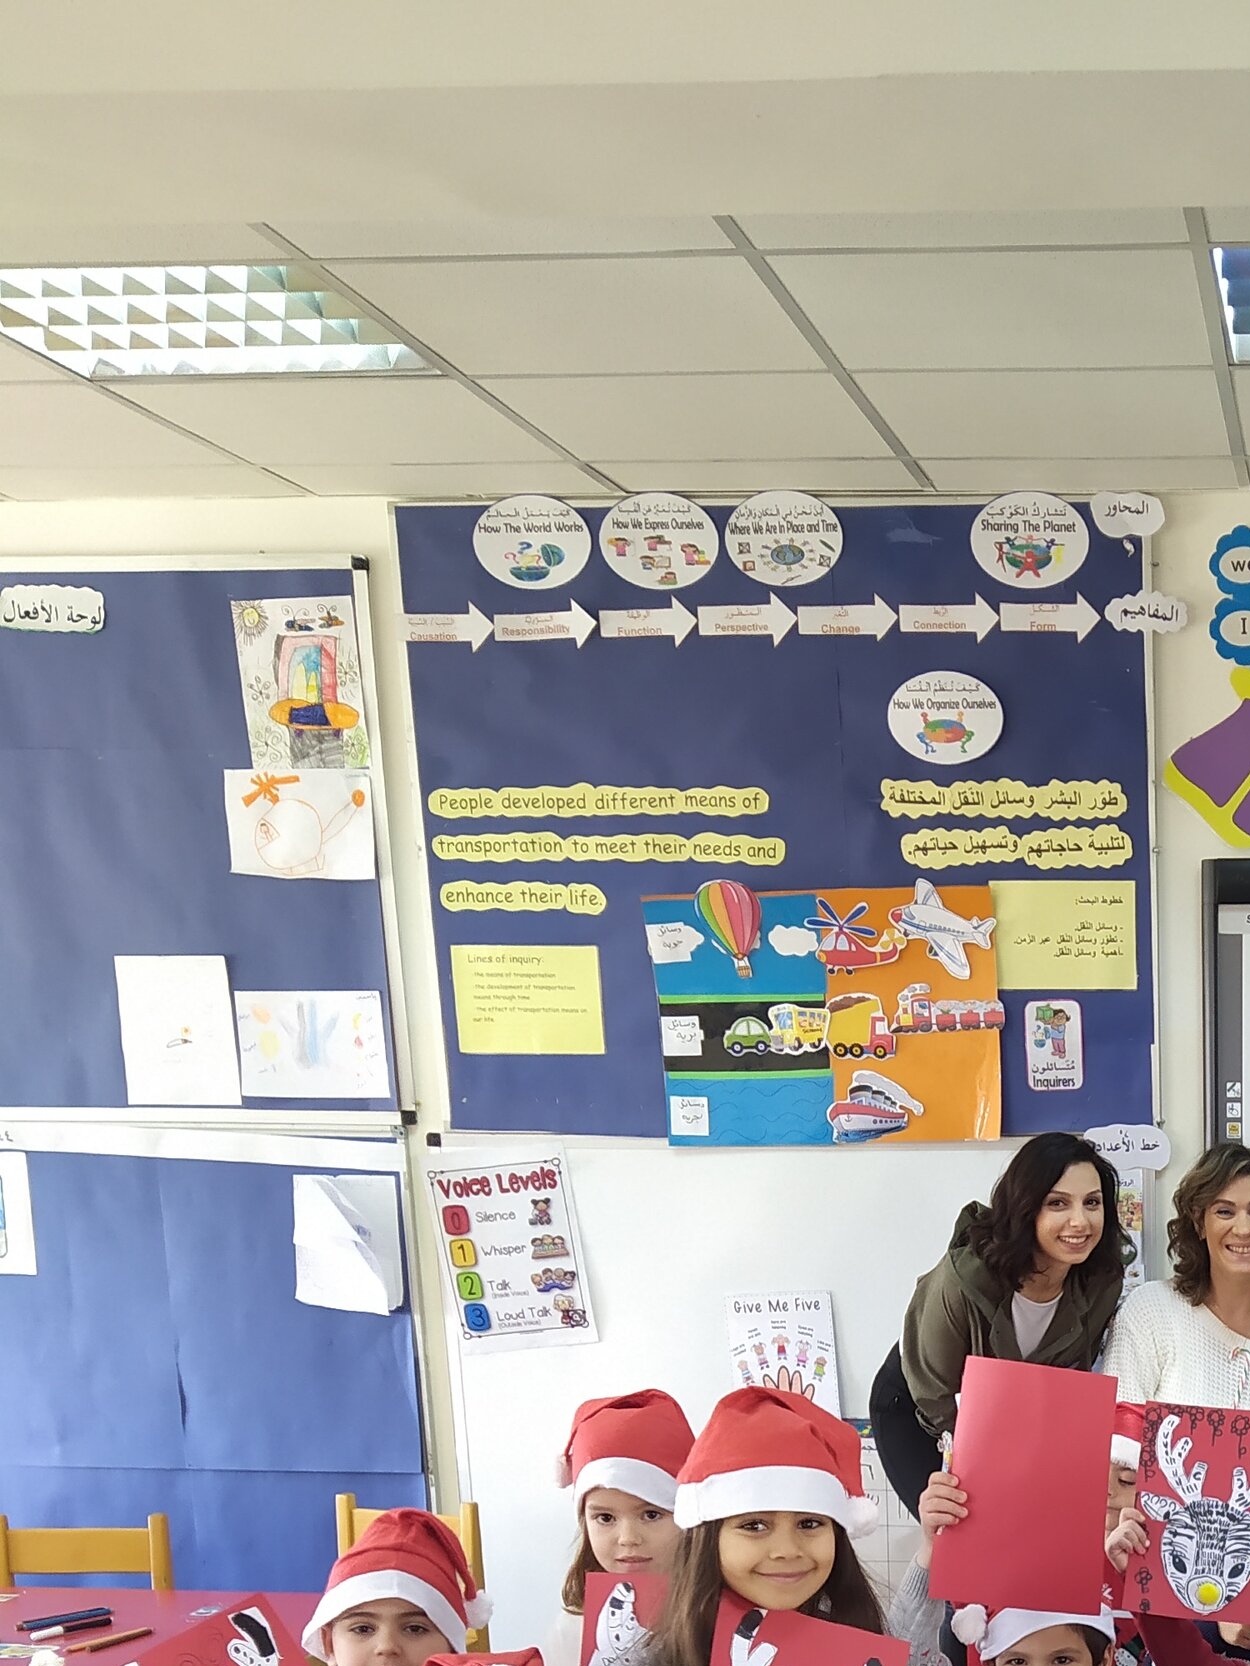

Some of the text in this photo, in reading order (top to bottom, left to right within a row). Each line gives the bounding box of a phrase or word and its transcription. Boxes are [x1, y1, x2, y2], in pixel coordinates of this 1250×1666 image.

[1104, 500, 1149, 517] المحاور
[478, 521, 584, 534] How The World Works
[612, 517, 704, 532] How We Express Ourselves
[728, 519, 838, 536] Where We Are In Place and Time
[981, 518, 1076, 535] Sharing The Planet
[66, 604, 102, 631] لوحة
[1119, 602, 1179, 624] المفاهيم
[501, 624, 570, 637] Responsibility
[617, 625, 663, 636] Function
[714, 622, 769, 633] Perspective
[821, 623, 860, 635] Change
[912, 620, 967, 630] Connection
[1029, 621, 1057, 632] Form
[1240, 617, 1247, 635] I
[410, 630, 458, 641] Causation
[893, 698, 996, 712] How We Organize Ourselves
[438, 792, 761, 814] People developed different means of
[889, 789, 946, 807] المختلفة
[1044, 790, 1082, 810] البشر
[437, 837, 776, 859] transportation to meet their needs and
[963, 835, 1018, 856] وتسهيل
[1027, 840, 1083, 860] حاجاتهم
[1088, 834, 1126, 856] لتلبية
[445, 887, 602, 906] enhance their life.
[467, 953, 493, 964] Lines
[496, 953, 506, 964] of
[1032, 1074, 1076, 1090] Inquirers
[437, 1166, 558, 1200] Voice Levels
[475, 1209, 517, 1224] Silence
[481, 1243, 527, 1259] Whisper
[488, 1279, 511, 1292] Talk
[496, 1307, 525, 1322] Loud
[528, 1305, 552, 1320] Talk
[734, 1297, 821, 1314] Give Me Five
